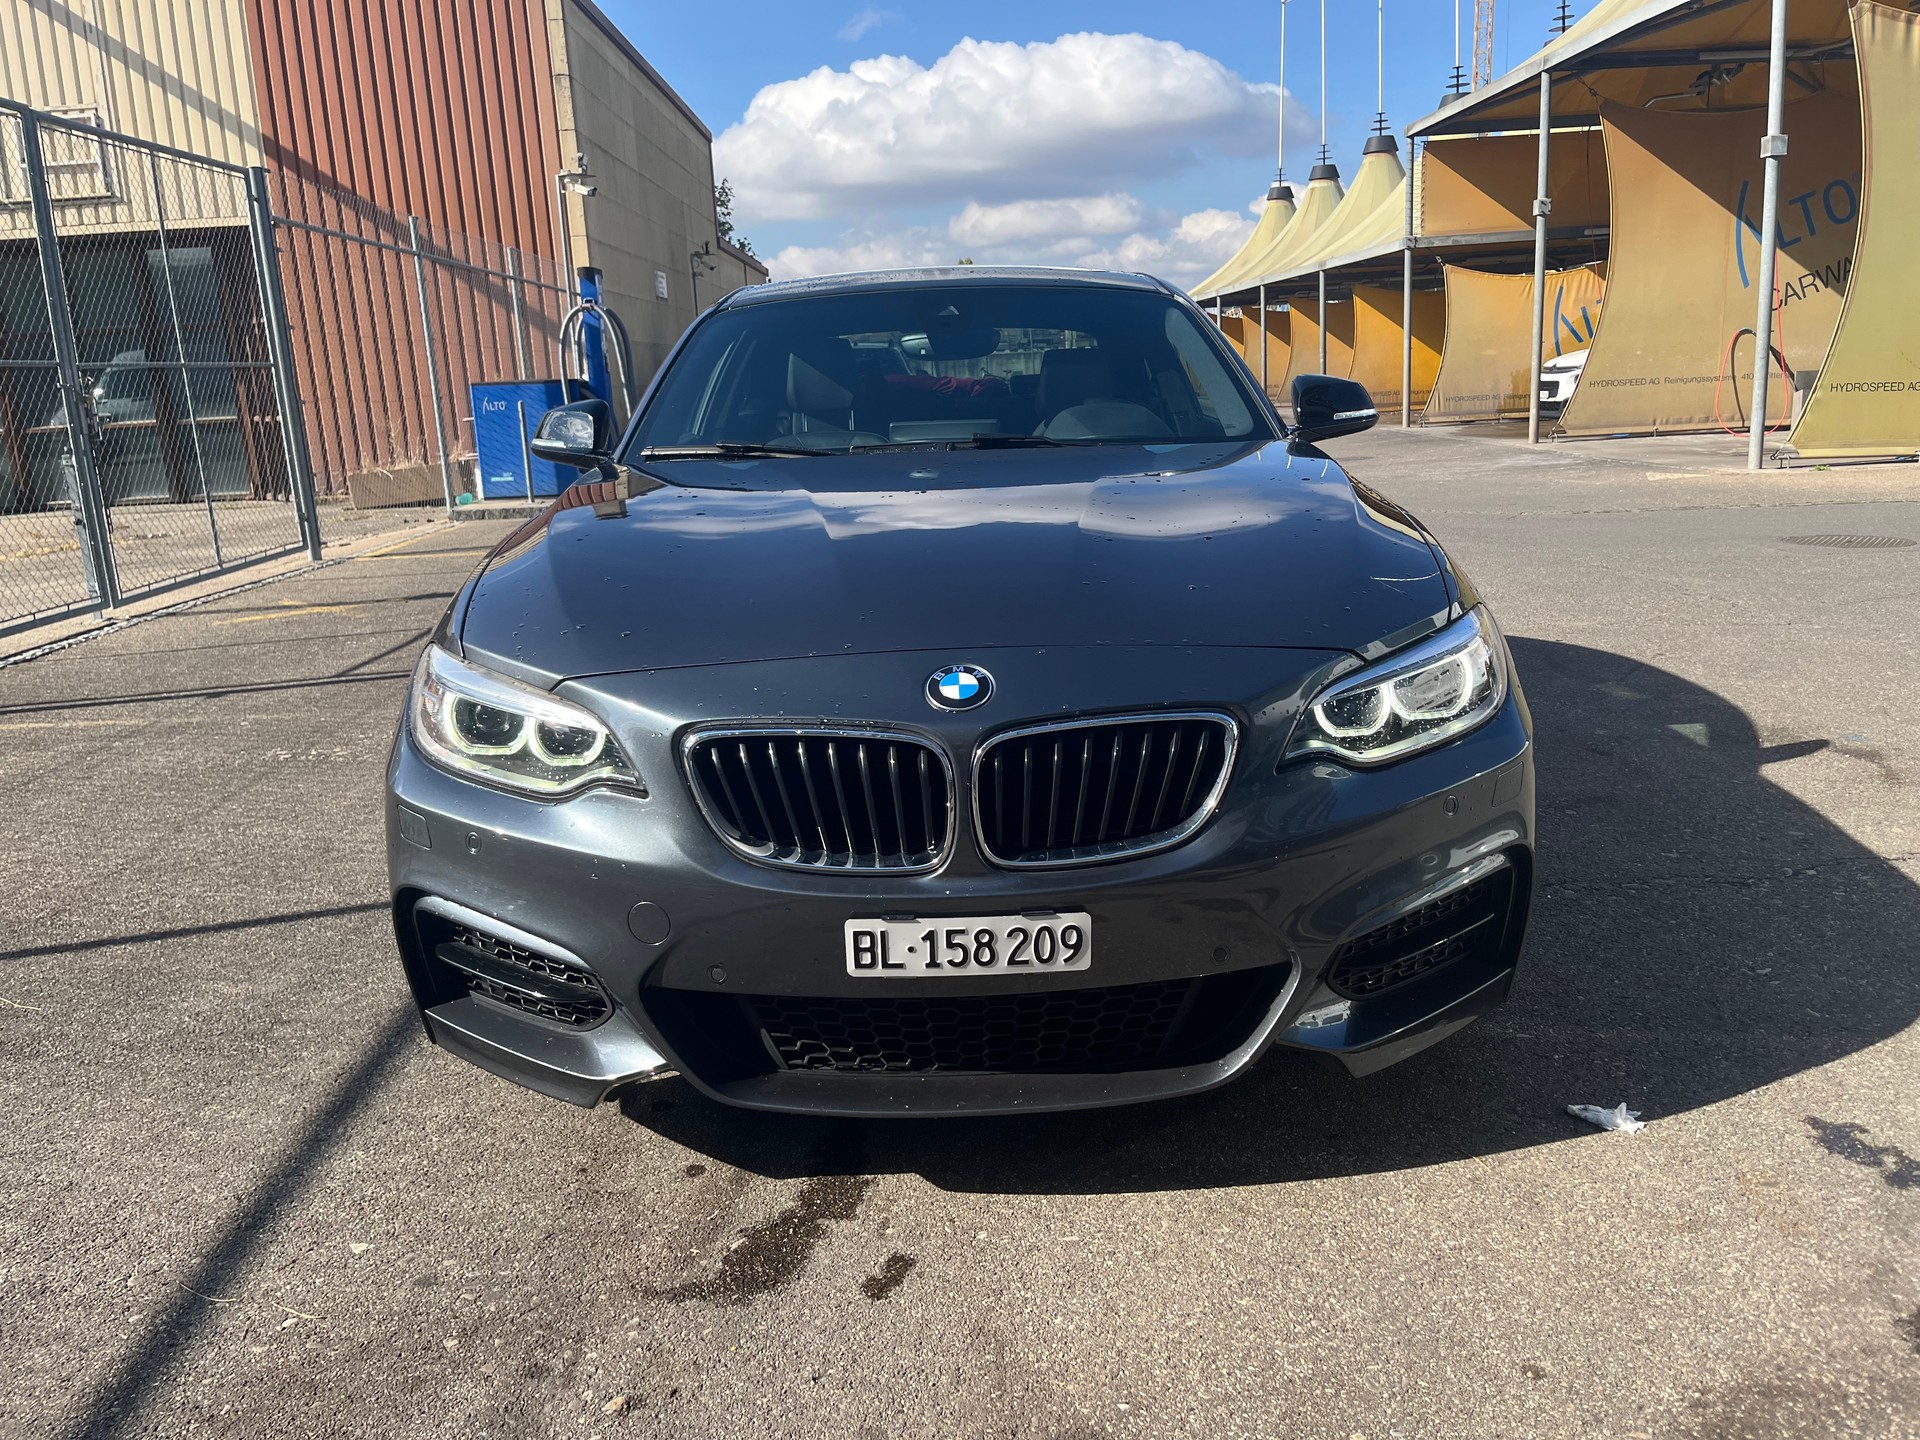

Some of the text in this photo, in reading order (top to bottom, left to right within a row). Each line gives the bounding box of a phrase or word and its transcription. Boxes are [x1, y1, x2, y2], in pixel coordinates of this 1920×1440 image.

[1589, 378, 1647, 388] HYDROSPEED
[1649, 377, 1660, 385] AG
[1830, 381, 1920, 392] HYDROSPEED AG
[1446, 394, 1491, 402] HYDROSPEED
[483, 397, 506, 415] ALTO
[933, 666, 985, 681] BMW
